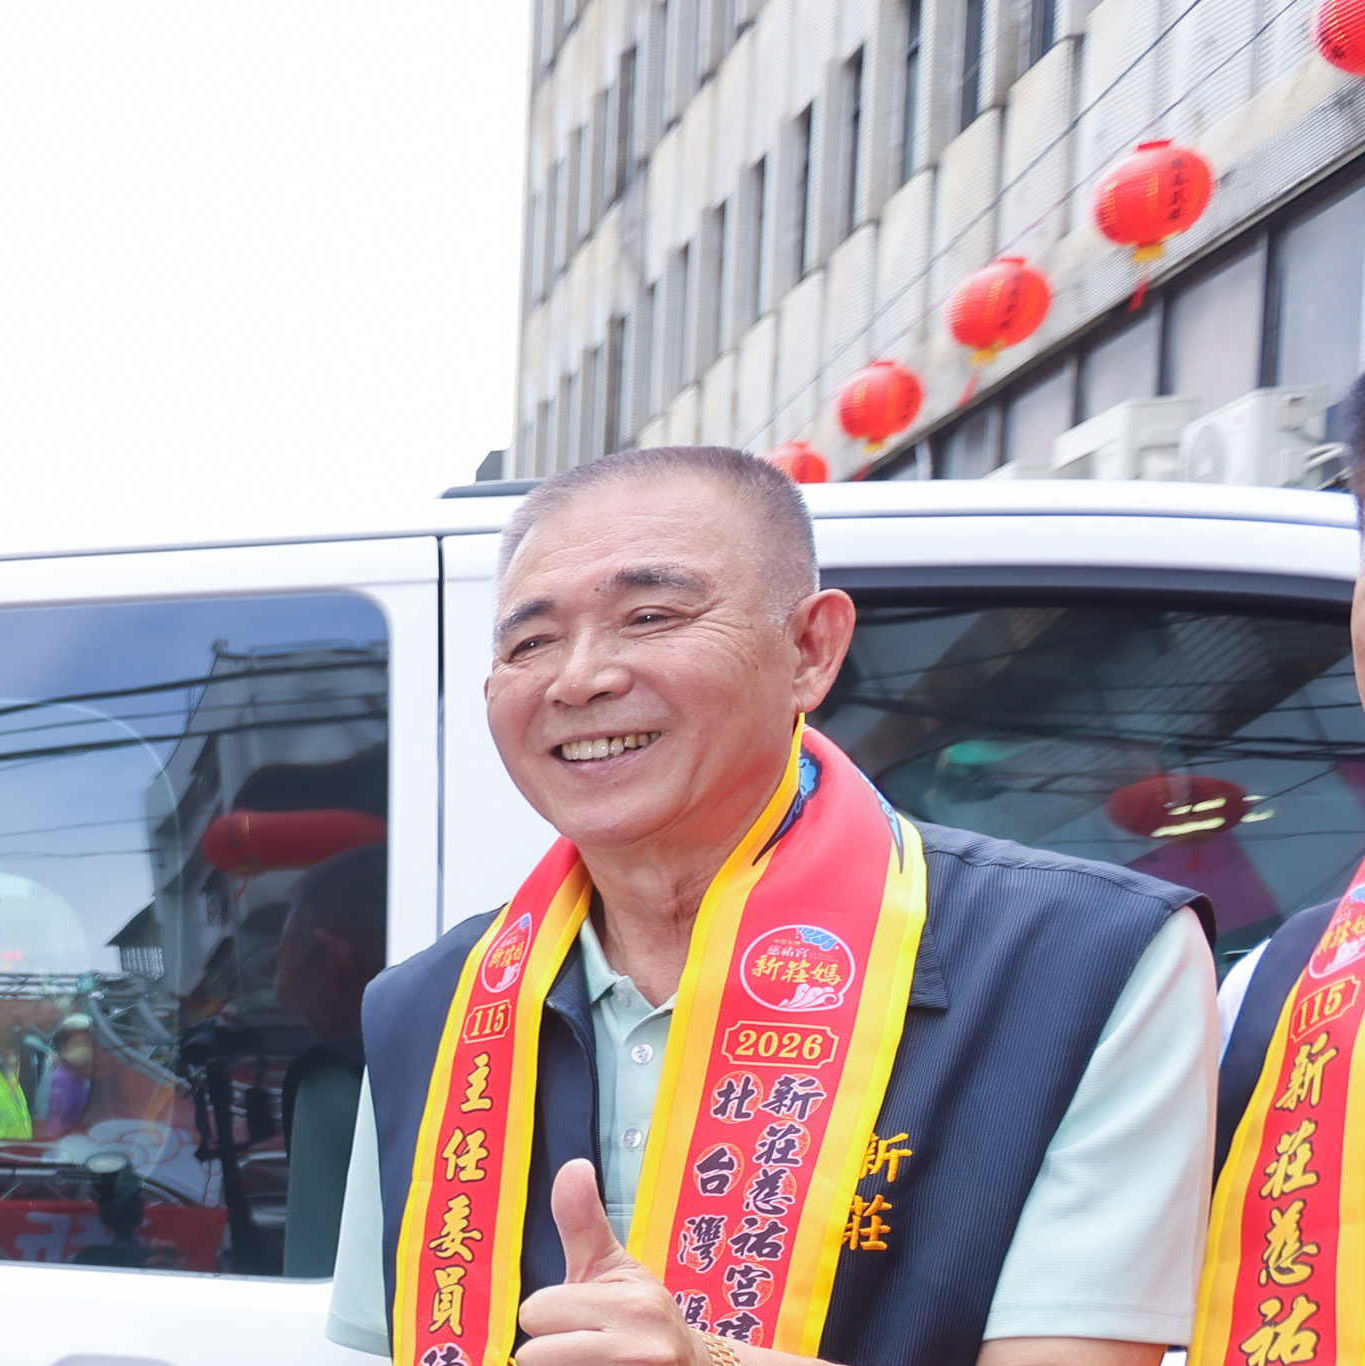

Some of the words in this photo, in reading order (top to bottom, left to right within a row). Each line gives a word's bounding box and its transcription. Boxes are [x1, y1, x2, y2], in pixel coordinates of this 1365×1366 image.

[751, 954, 843, 986] 新莊媽
[470, 1004, 506, 1036] 115
[1297, 983, 1346, 1033] 115
[735, 1029, 824, 1060] 2026
[842, 1132, 913, 1251] 新莊
